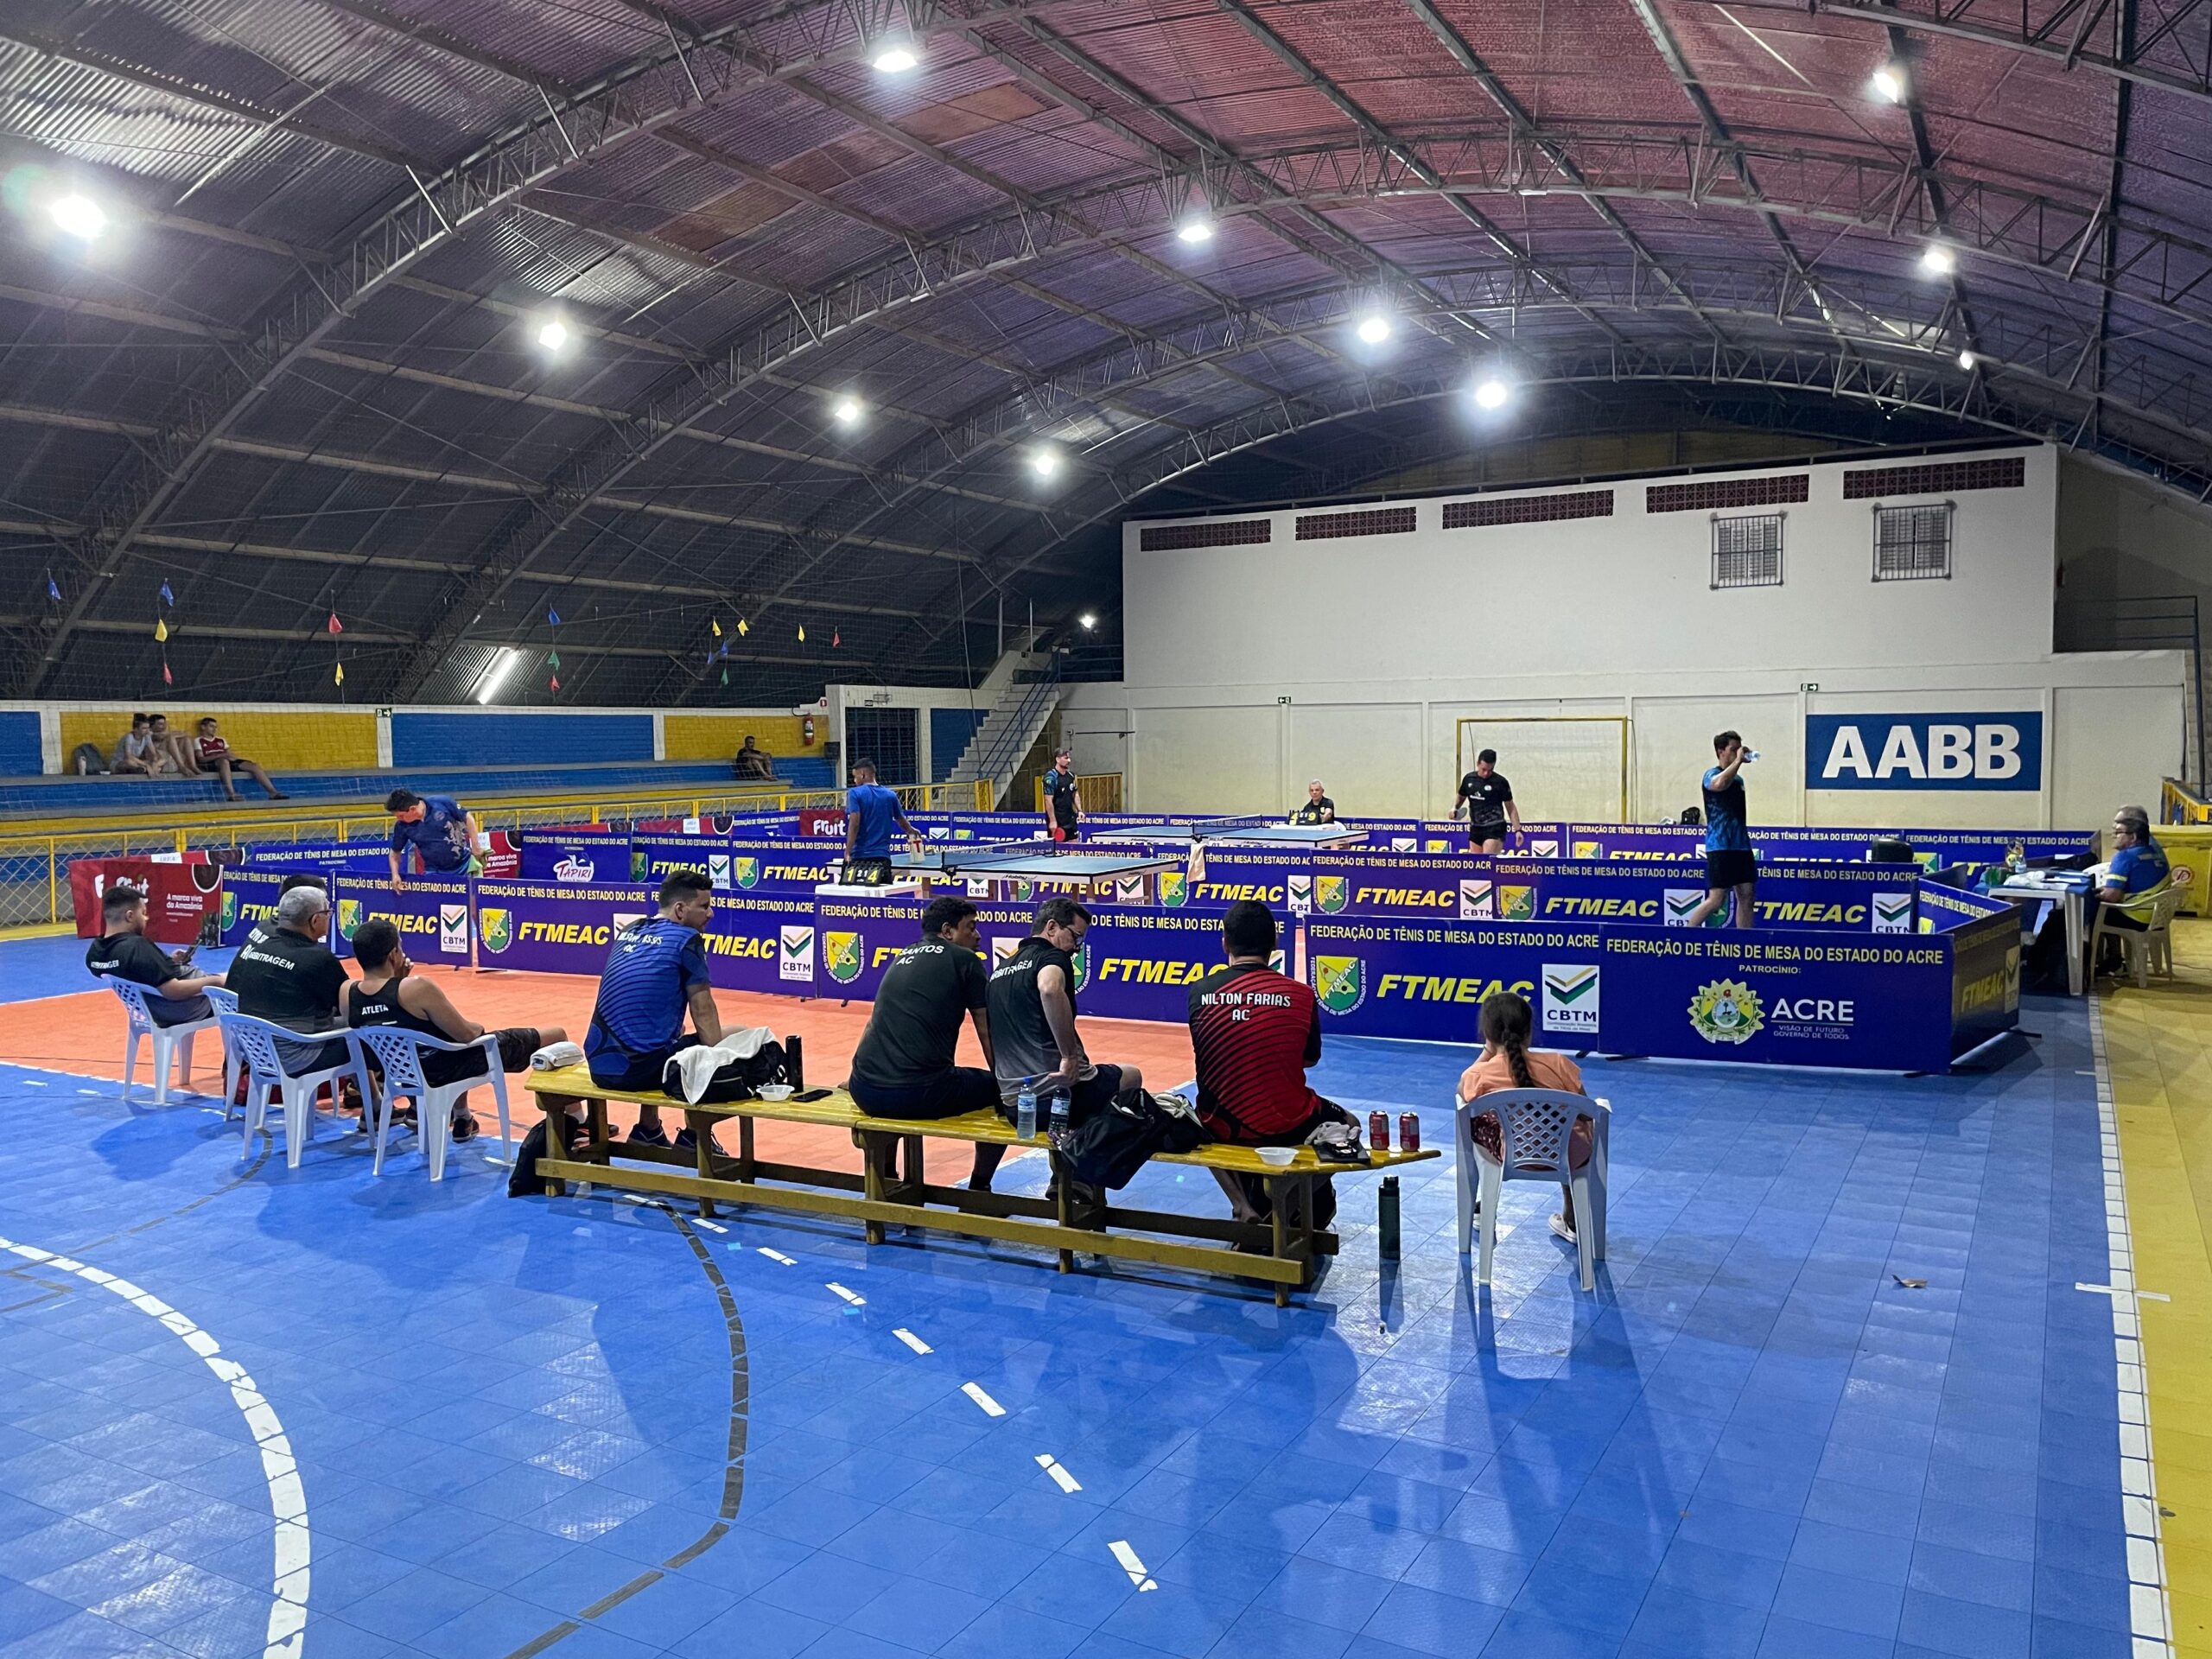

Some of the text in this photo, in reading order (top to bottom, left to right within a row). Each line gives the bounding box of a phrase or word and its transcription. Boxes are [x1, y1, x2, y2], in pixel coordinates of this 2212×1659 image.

[1821, 724, 2021, 779] AABB
[814, 819, 846, 836] Fruit
[1573, 825, 1607, 834] FEDERAÇÃO
[1618, 825, 1634, 834] TÊNIS
[1781, 831, 1798, 840] TÊNIS
[1906, 835, 1948, 844] FEDERAÇÃO
[1961, 835, 1980, 843] TÊNIS
[1206, 853, 1223, 862] TÊNIS
[1264, 855, 1289, 864] ESTADO
[1291, 856, 1300, 865] DO
[1313, 855, 1353, 867] FEDERAÇÃO
[1356, 857, 1364, 866] DE
[1367, 856, 1386, 866] TÊNIS
[1388, 858, 1397, 867] DE
[1399, 859, 1419, 868] MESA
[1421, 859, 1430, 868] DO
[1433, 860, 1461, 868] ESTADO
[556, 863, 591, 878] TAPIRI
[763, 866, 830, 881] FTMEAC
[868, 870, 878, 883] 4
[1496, 864, 1704, 879] FEDERAÇÃO DE TÊNIS DE MESA DO ESTADO DO ACRE
[1758, 867, 1781, 878] TÊNIS
[1783, 869, 1795, 879] DE
[1798, 869, 1820, 879] MESA
[1824, 870, 1836, 880] DO
[1839, 870, 1875, 880] ESTADO
[1877, 871, 1890, 880] DO
[337, 878, 467, 893] FEDERAÇÃO DE TÊNIS DO ESTADO DO ACRE
[1195, 883, 1284, 901] FTMEAC
[478, 885, 645, 901] FEDERAÇÃO DE TÊNIS DE MESA DO ESTADO DO ACRE
[1356, 888, 1455, 907] FTMEAC
[718, 898, 814, 912] DE MESA DO ESTADO DO ACRE
[1545, 897, 1658, 917] FTMEAC
[821, 906, 1033, 923] FEDERAÇÃO DE TÊNIS DE DO ACRE
[1100, 914, 1224, 931] DE TÊNIS DE MESA DO ESTA
[518, 922, 610, 944] FTMEAC
[1311, 925, 1599, 947] FEDERAÇÃO DE TÊNIS DE MESA DO ESTADO DO ACRE
[442, 937, 466, 945] CBTM
[899, 944, 944, 957] SANTOS
[1607, 939, 1943, 963] FEDERAÇÃO DE TÊNIS DE MESA DO ESTADO DO ACRE
[783, 963, 810, 972] CBTM
[897, 956, 914, 965] AC
[1738, 964, 1801, 975] PATROCÍNIO:
[1325, 961, 1356, 999] FTMEAC
[1201, 994, 1290, 1007] NILTON FARIAS
[361, 1004, 389, 1014] ATLETA
[1232, 1009, 1249, 1020] AC
[1547, 1009, 1597, 1022] CBTM
[1771, 998, 1853, 1021] ACRE
